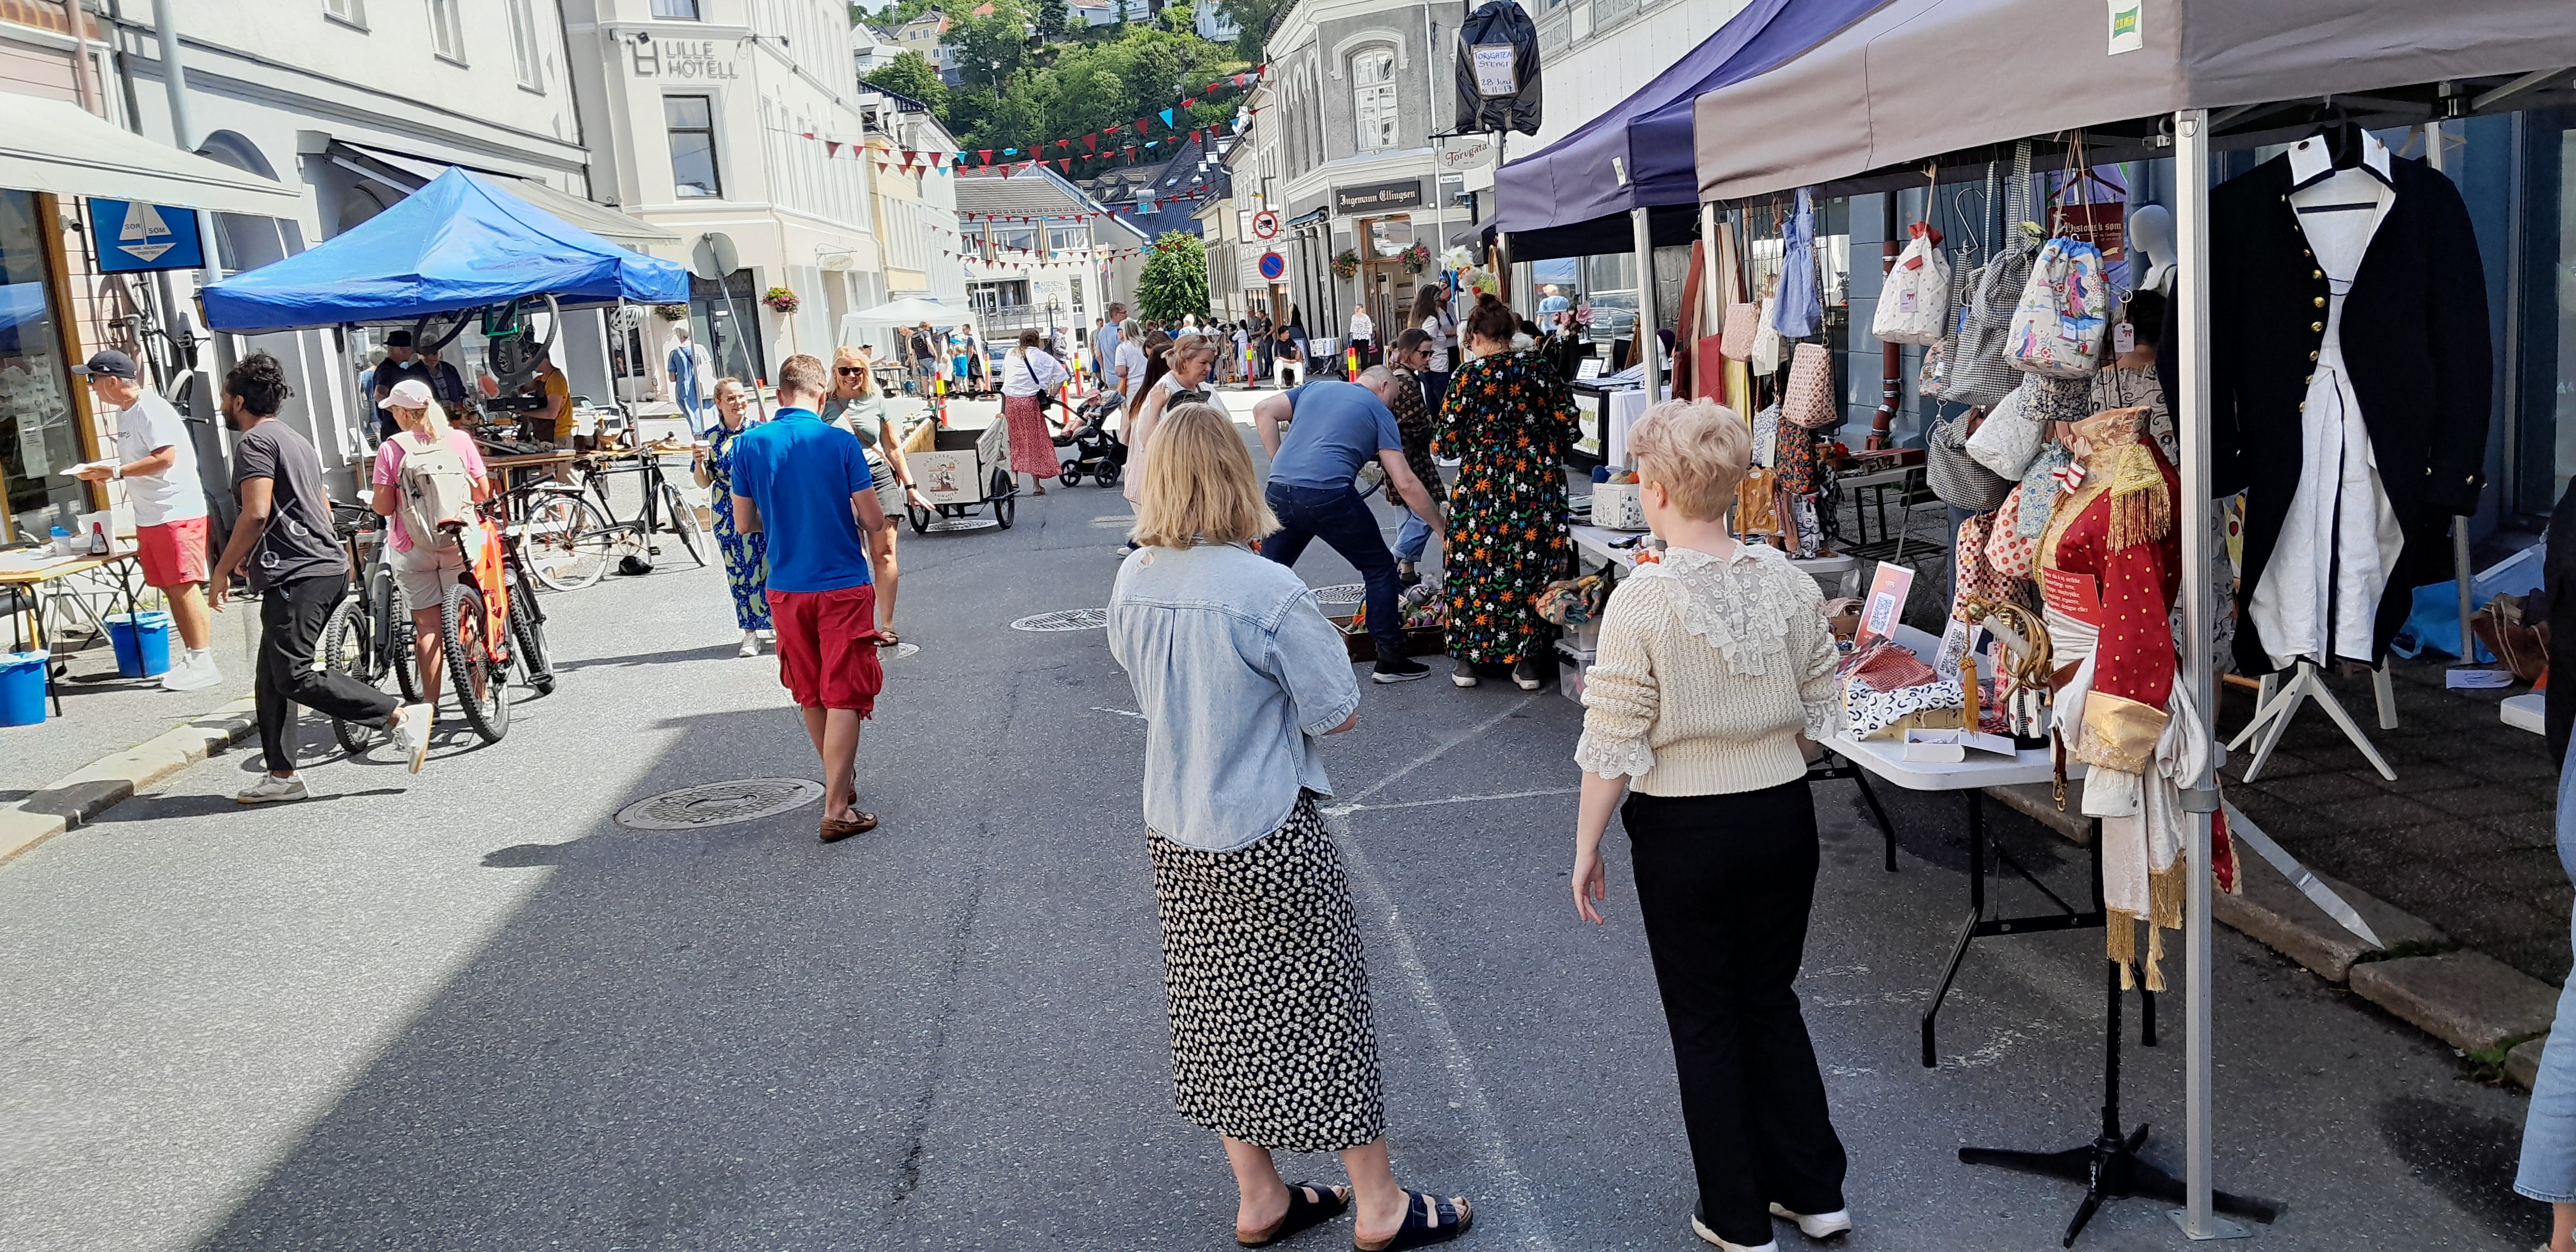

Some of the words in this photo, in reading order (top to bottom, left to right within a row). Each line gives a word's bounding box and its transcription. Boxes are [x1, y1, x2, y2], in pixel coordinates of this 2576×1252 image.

[666, 41, 714, 59] LILLE
[668, 60, 740, 79] HOTELL
[1446, 143, 1487, 166] Torvgata
[1339, 195, 1377, 208] Ingemann
[1379, 189, 1415, 202] Ellingsen
[2105, 222, 2122, 231] søm
